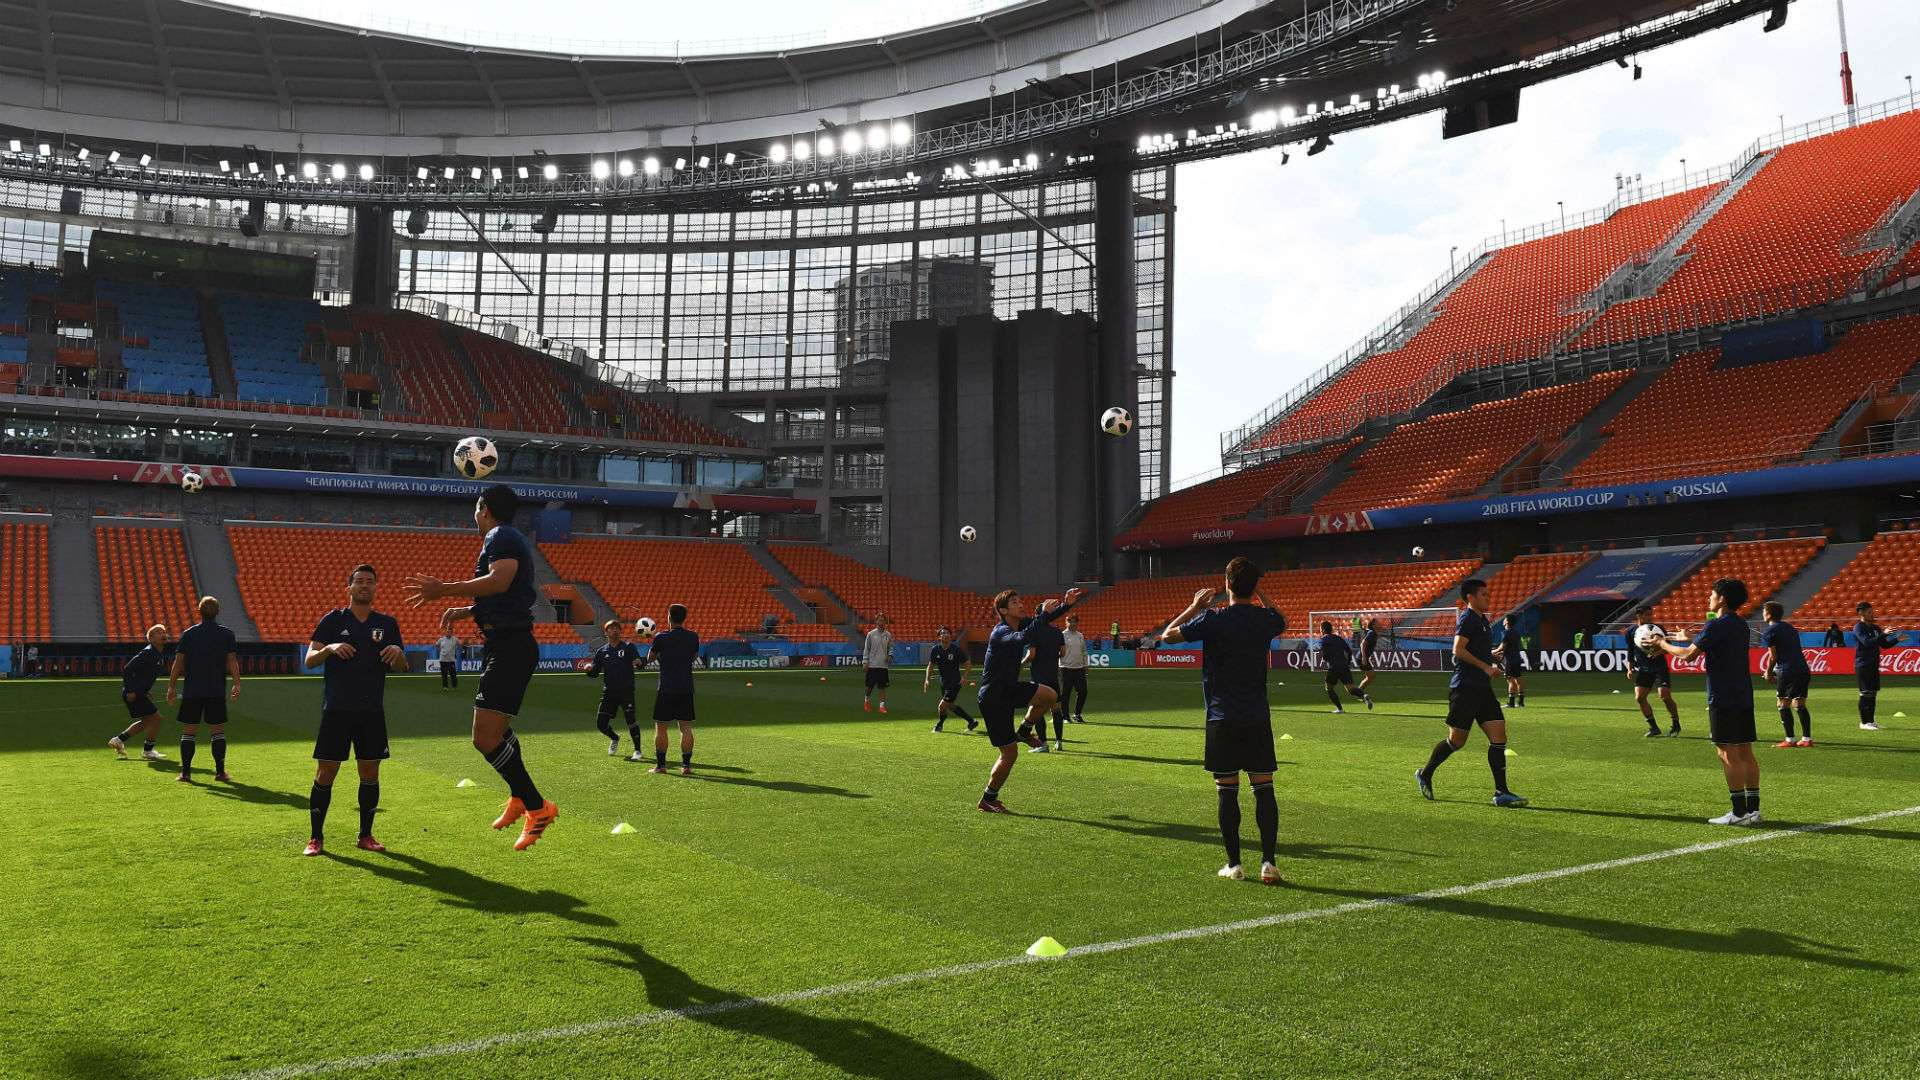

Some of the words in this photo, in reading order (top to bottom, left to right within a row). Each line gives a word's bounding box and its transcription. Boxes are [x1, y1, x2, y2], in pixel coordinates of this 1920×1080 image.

[305, 476, 374, 489] ЧЕМПИОНАТ
[377, 480, 410, 491] МИРА
[412, 482, 427, 491] ПО
[429, 483, 478, 495] ФУТБОЛУ
[537, 488, 579, 500] РОССИИ
[1481, 503, 1509, 516] 2018
[1510, 500, 1537, 513] FIFA
[1538, 495, 1584, 511] WORLD
[1586, 492, 1614, 507] CUP
[1672, 481, 1728, 497] RUSSIA
[1191, 528, 1234, 539] #worldcup
[709, 656, 768, 669] Hisense
[801, 656, 823, 667] Bud
[1156, 654, 1196, 663] McDonald's
[1540, 650, 1630, 672] MOTOR
[461, 660, 482, 671] GAZP
[538, 660, 573, 669] WANDA
